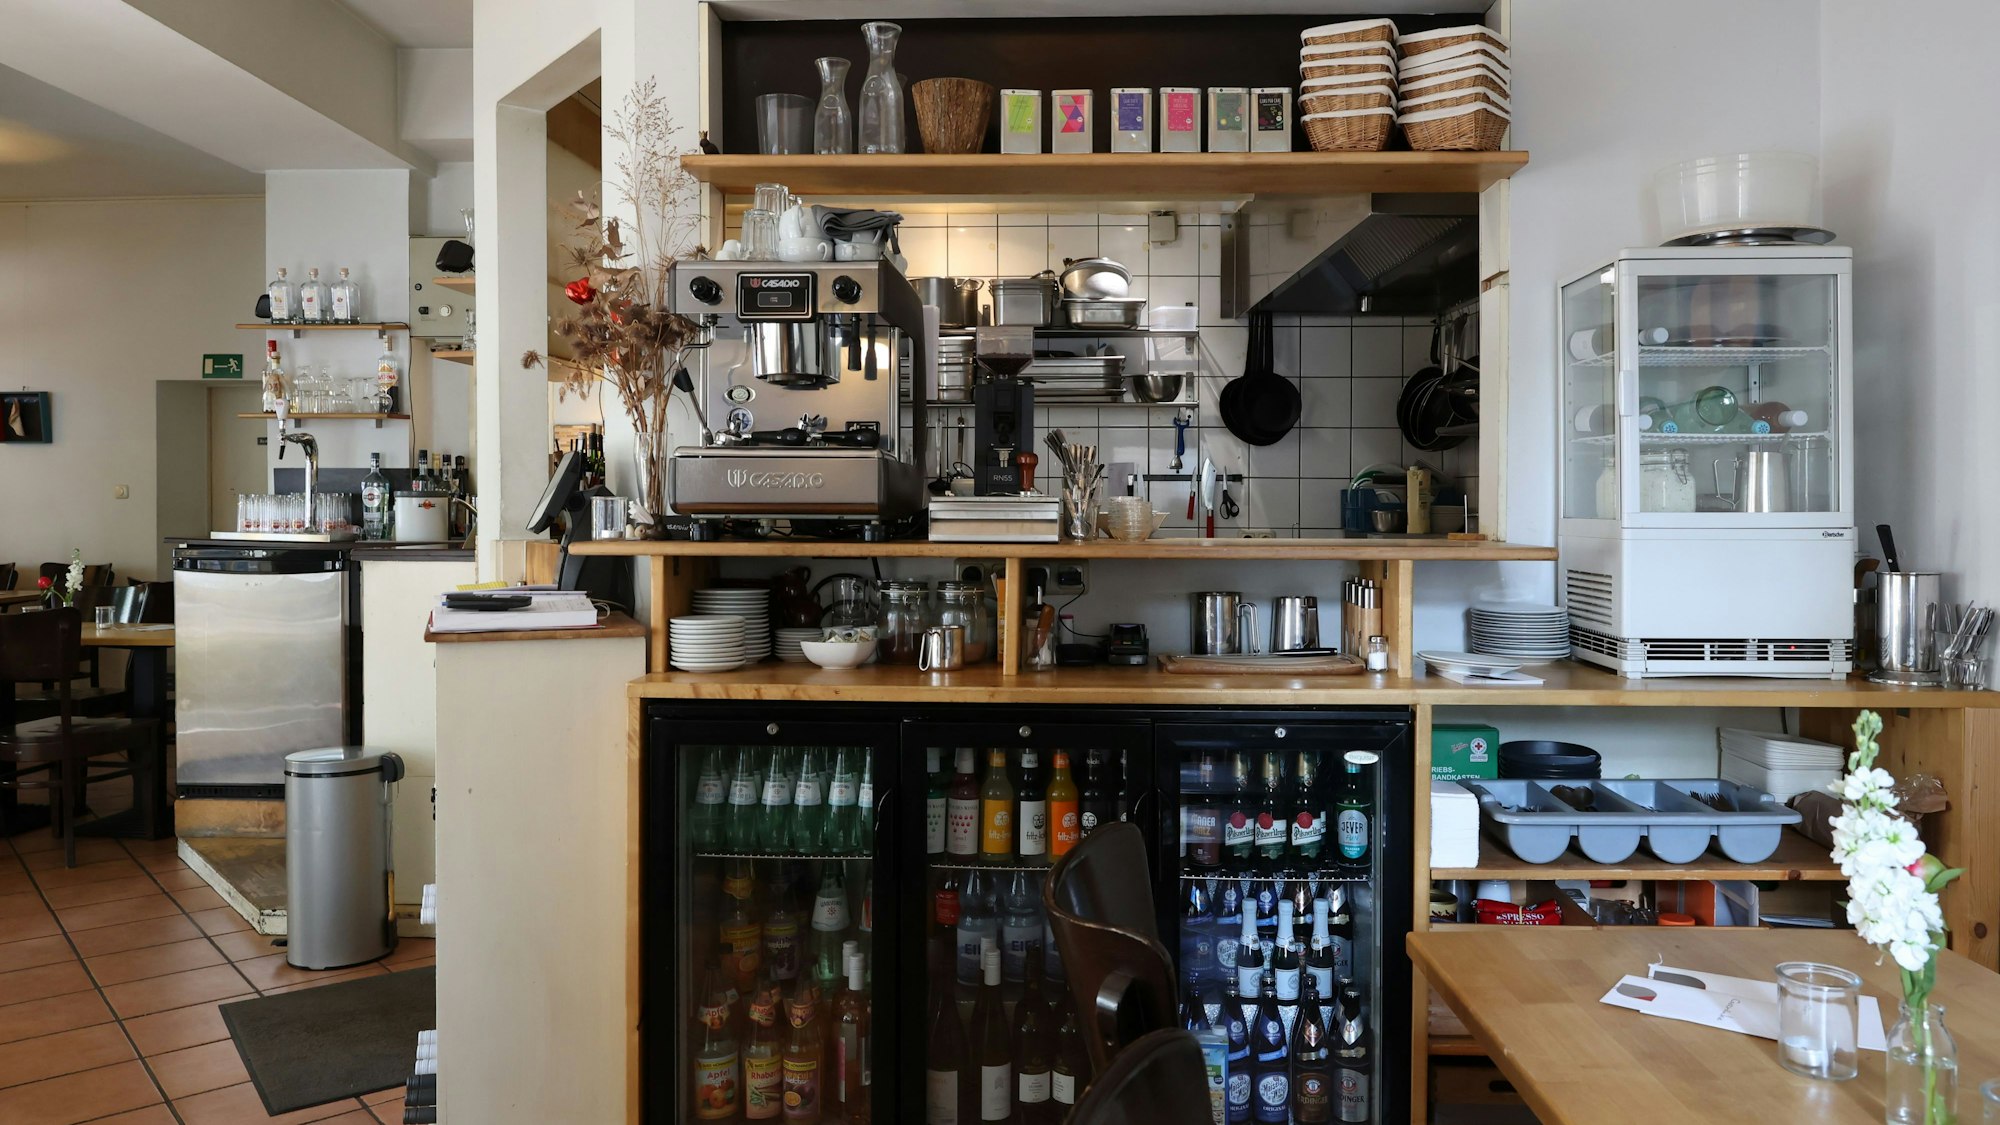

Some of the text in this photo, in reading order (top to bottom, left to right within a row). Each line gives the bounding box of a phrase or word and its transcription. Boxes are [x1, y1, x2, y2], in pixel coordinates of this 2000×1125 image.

[761, 279, 800, 288] CASADIO
[749, 472, 825, 488] CASADIO
[1341, 821, 1364, 835] JEVER
[706, 1067, 730, 1080] Apfel
